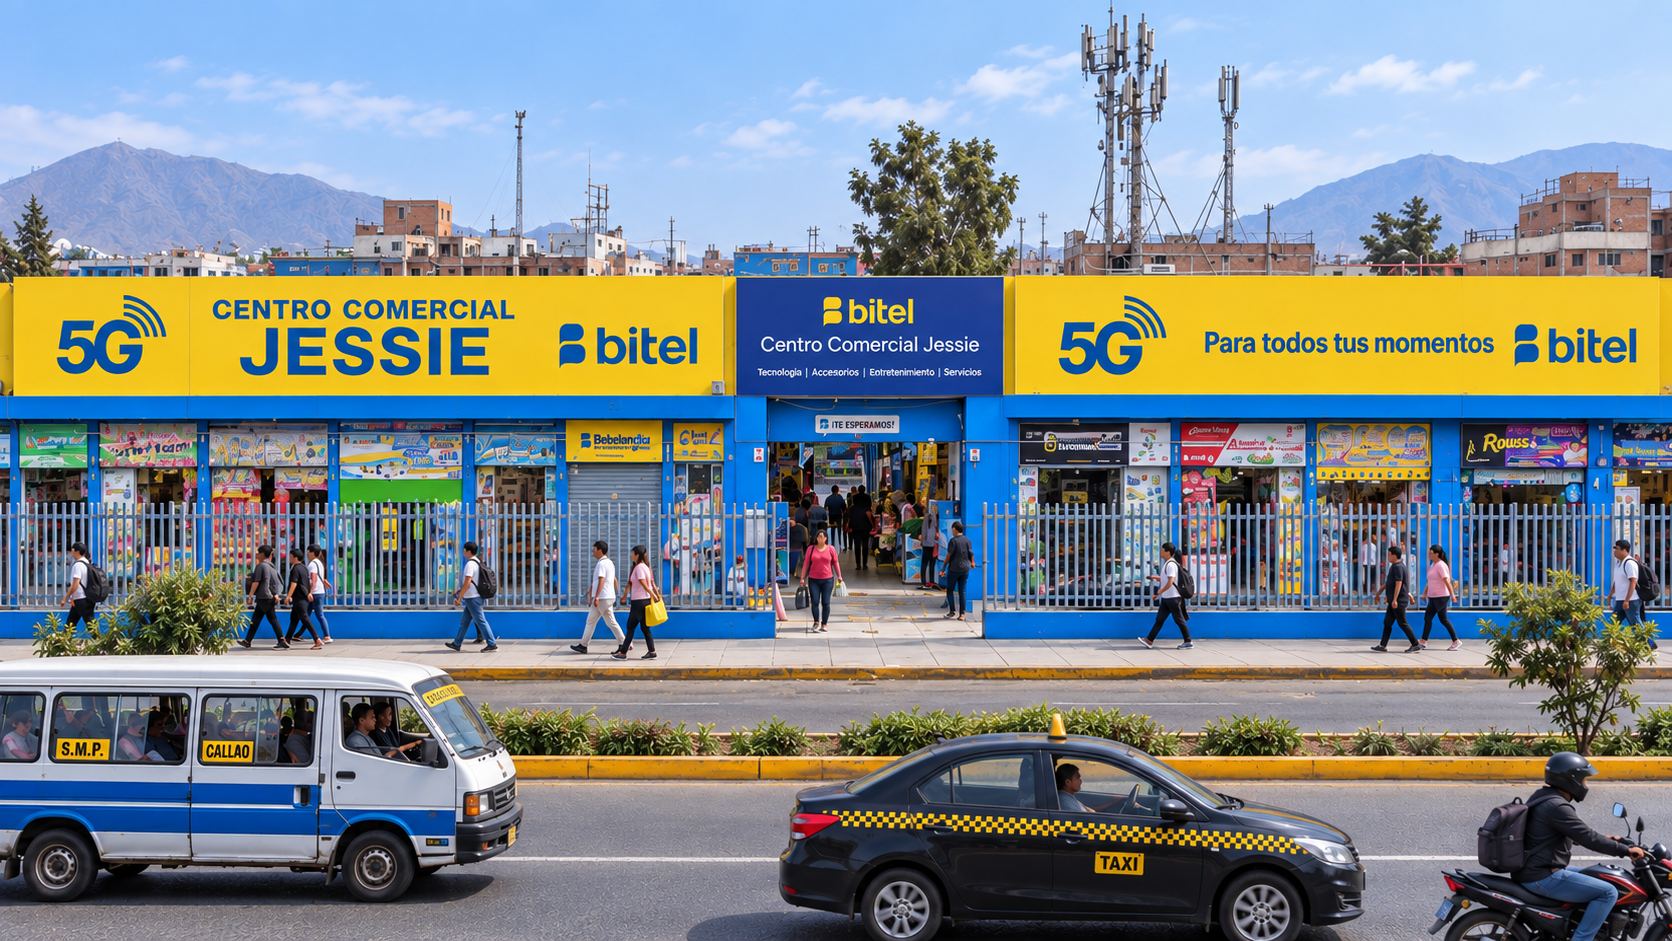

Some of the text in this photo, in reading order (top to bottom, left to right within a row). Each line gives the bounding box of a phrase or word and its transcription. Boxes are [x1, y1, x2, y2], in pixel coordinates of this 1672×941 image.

[213, 299, 515, 320] CENTRO COMERCIAL
[849, 298, 914, 325] bitel
[57, 320, 143, 375] 5G
[240, 327, 490, 376] JESSIE
[597, 326, 698, 365] bitel
[761, 336, 980, 352] Centro Comercial Jessie
[1059, 321, 1143, 376] 5G
[1204, 331, 1495, 354] Para todos tus momentos
[1548, 327, 1637, 364] bitel
[811, 367, 860, 377] Accesorios
[943, 367, 983, 377] Servicios
[845, 420, 895, 429] ESPERAMOS!
[61, 741, 104, 757] S.M.P.
[206, 744, 250, 759] CALLAO
[1100, 855, 1138, 872] TAXI
